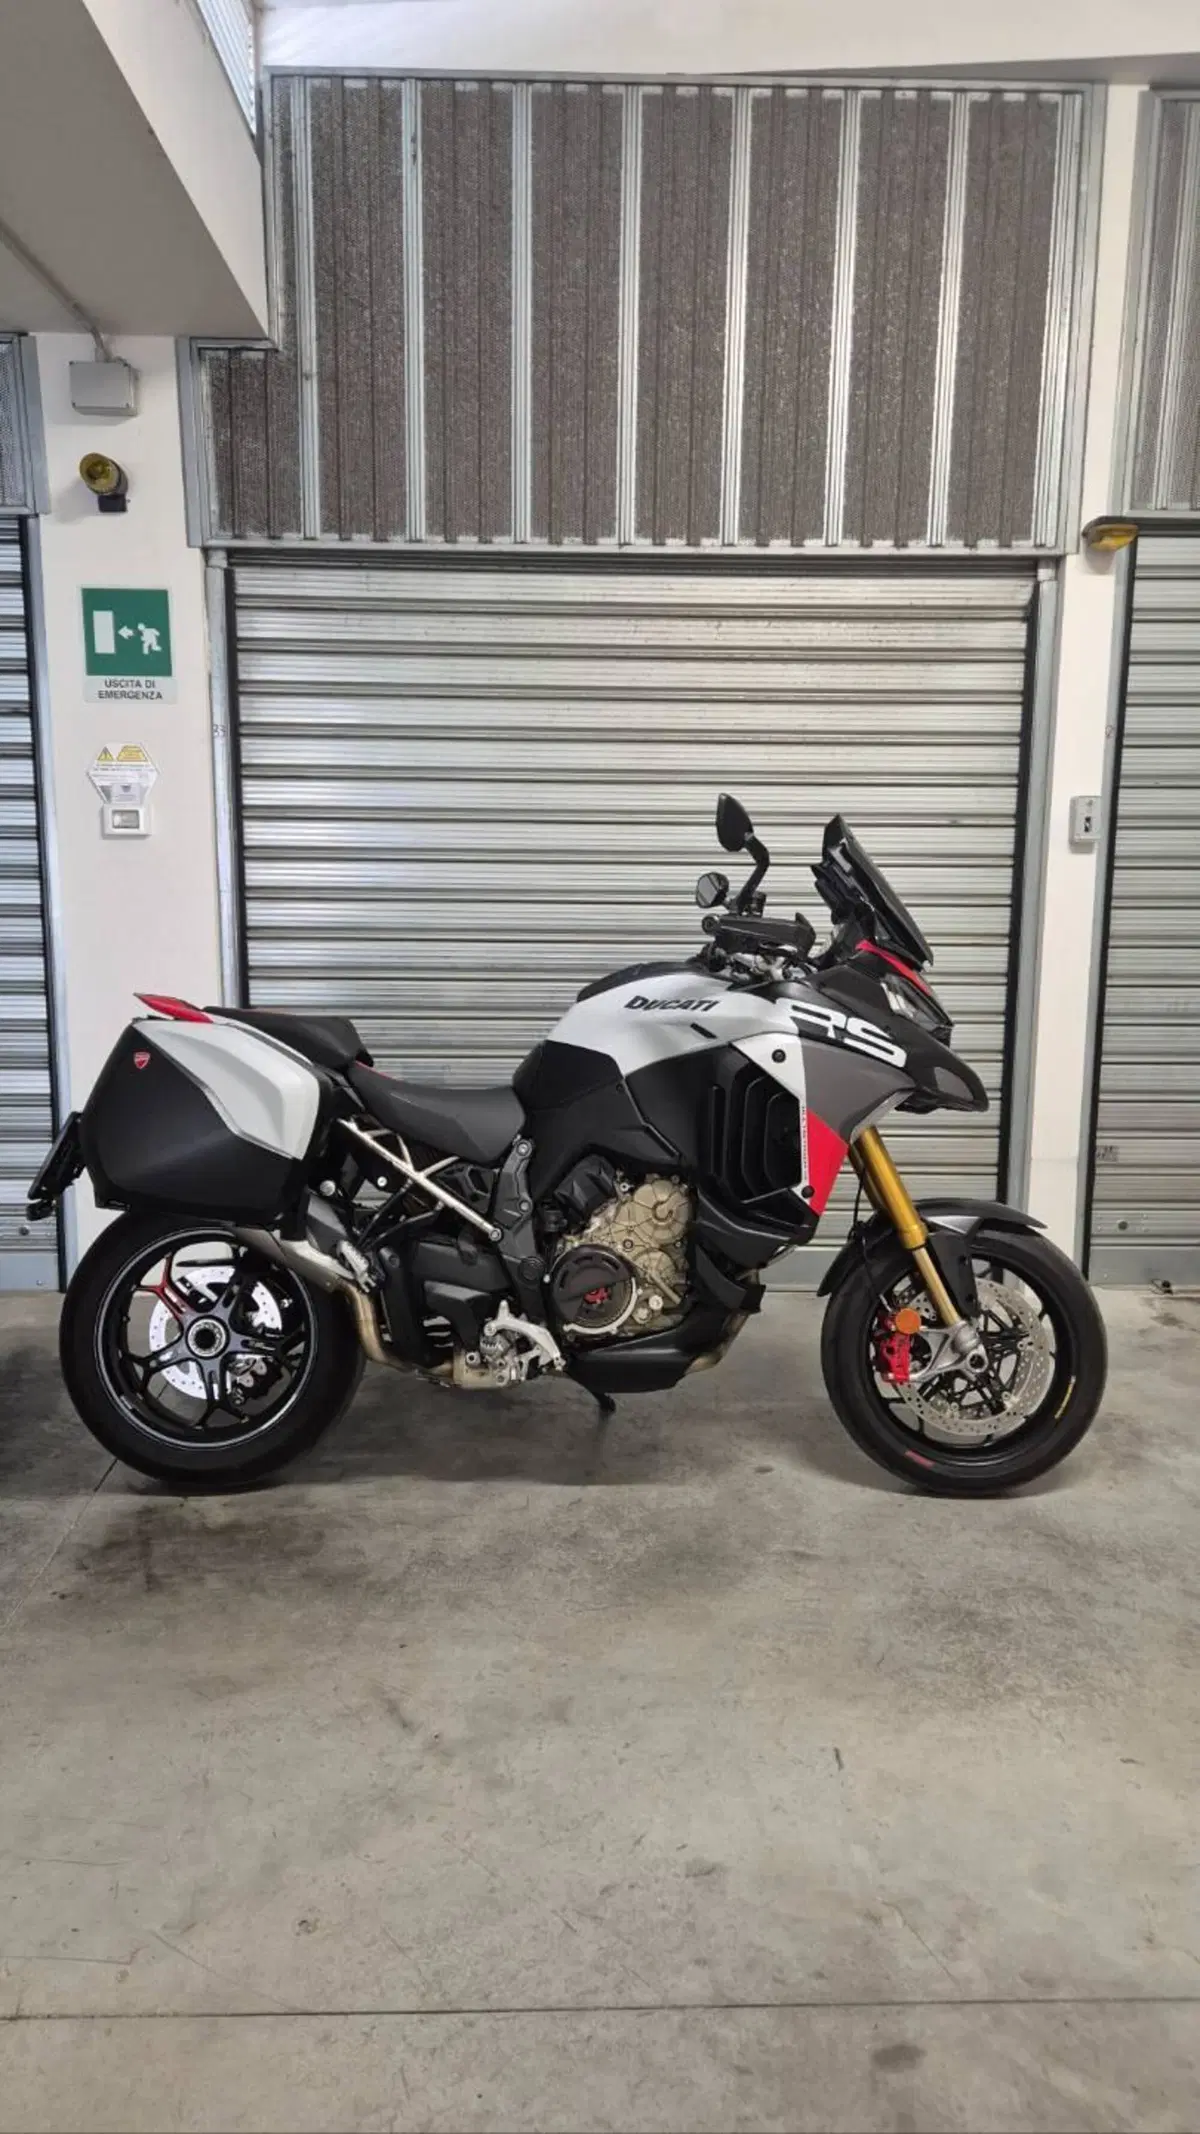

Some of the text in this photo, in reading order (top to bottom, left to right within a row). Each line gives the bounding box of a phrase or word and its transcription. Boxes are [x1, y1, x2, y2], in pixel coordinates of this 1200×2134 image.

[104, 679, 155, 689] USCITA DI
[98, 690, 163, 700] EMERGENZA
[624, 995, 720, 1012] DUCATI
[776, 998, 907, 1068] RS
